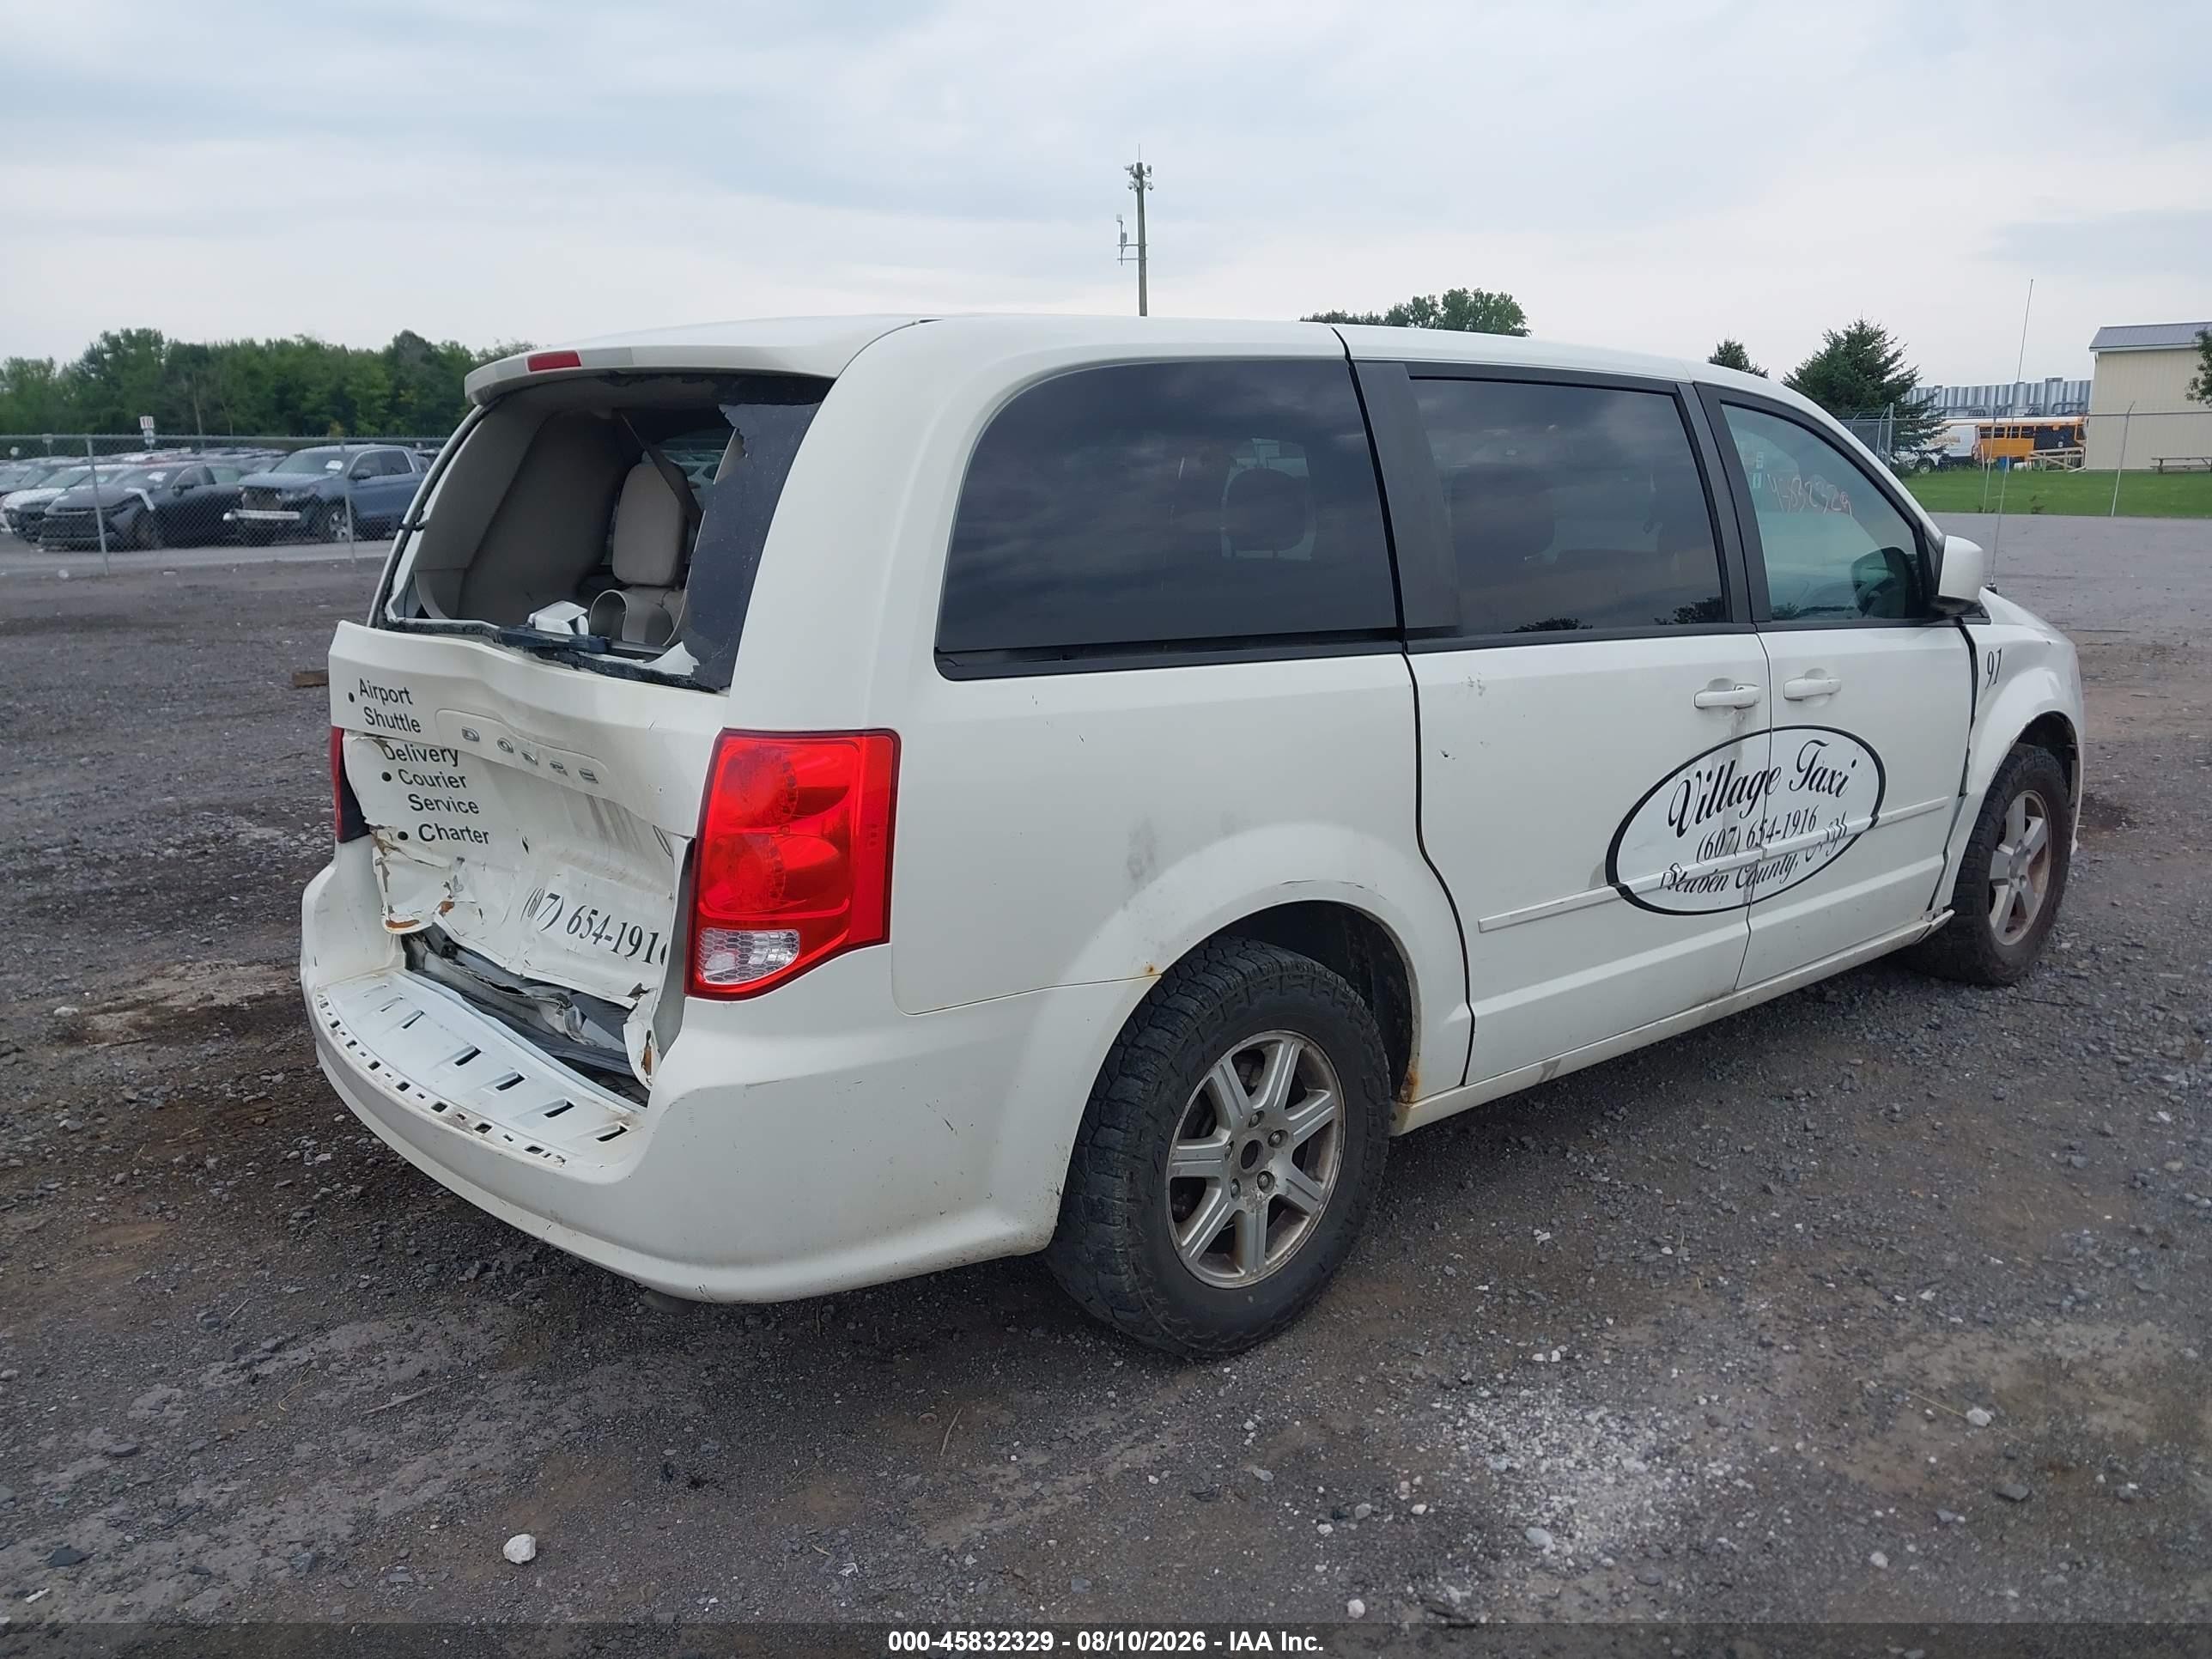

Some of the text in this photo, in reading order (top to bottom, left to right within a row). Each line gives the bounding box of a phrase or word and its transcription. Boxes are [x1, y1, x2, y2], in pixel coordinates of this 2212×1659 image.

[1984, 647, 2002, 690] 91
[359, 678, 413, 706] Airport
[363, 706, 421, 733] Shuttle
[383, 743, 459, 767] Delivery
[398, 769, 467, 788] Courier
[1668, 759, 1782, 838] Village
[1789, 739, 1857, 798] Taxi
[408, 793, 480, 814] Service
[418, 823, 489, 844] Charter
[1696, 824, 1741, 865] (607)
[1746, 805, 1820, 850] 654-1916
